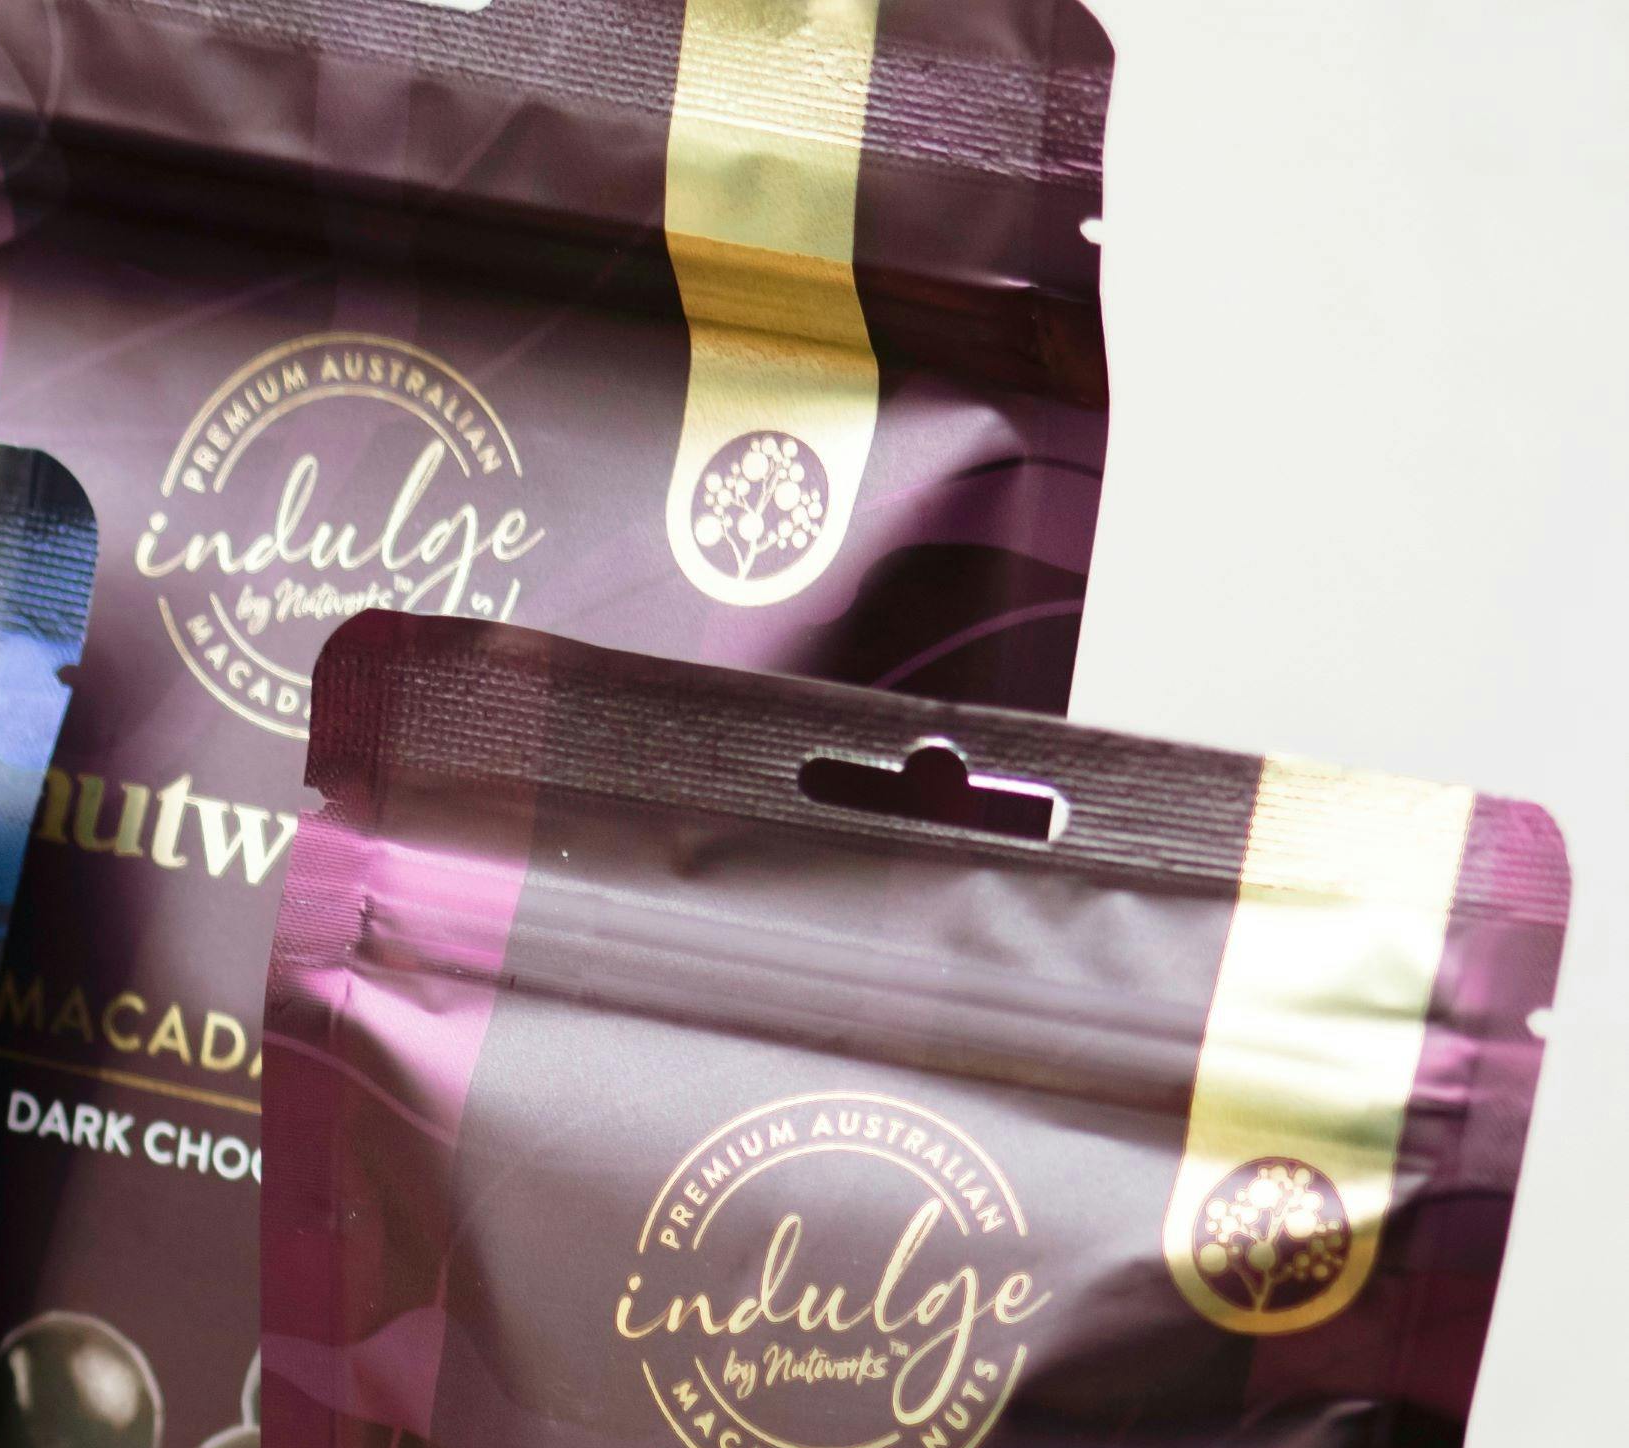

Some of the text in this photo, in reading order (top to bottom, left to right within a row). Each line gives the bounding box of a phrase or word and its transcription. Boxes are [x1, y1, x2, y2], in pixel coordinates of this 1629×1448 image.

[181, 352, 504, 494] PREMIUM AUSTRALIAN
[134, 438, 546, 617] indulge
[186, 614, 311, 721] MACAD
[7, 1088, 135, 1157] DARK
[659, 1110, 1005, 1250] PREMIUM AUSTRALIAN
[615, 1197, 1053, 1426] indulge
[723, 1346, 757, 1399] by
